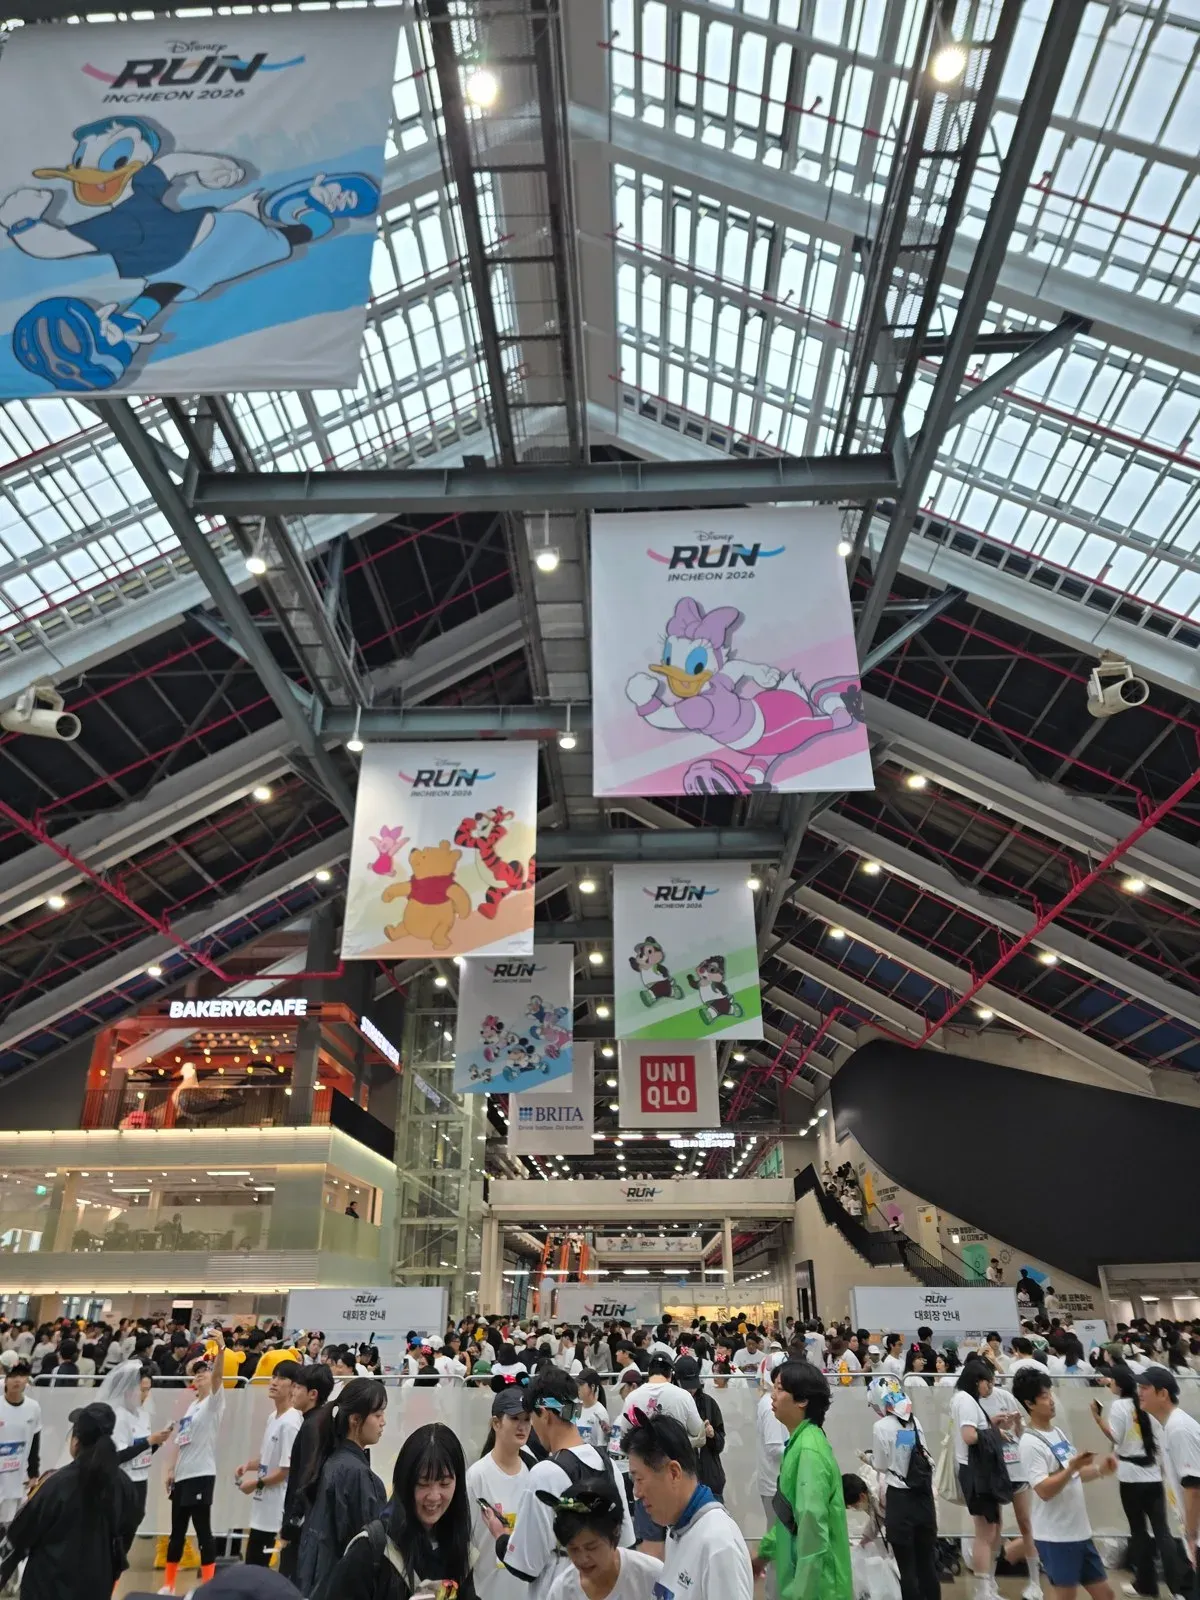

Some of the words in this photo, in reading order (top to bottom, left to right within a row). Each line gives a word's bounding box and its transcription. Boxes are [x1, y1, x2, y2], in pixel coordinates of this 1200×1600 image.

[165, 40, 228, 54] Disney
[109, 52, 268, 89] RUN
[102, 90, 195, 104] INCHEON
[197, 89, 246, 100] 2026
[693, 530, 735, 542] Disney
[668, 543, 762, 570] RUN
[667, 572, 723, 582] INCHEON
[725, 571, 756, 580] 2026
[412, 769, 479, 788] RUN
[451, 789, 472, 797] 2026
[654, 885, 706, 901] RUN
[493, 963, 536, 977] RUN
[169, 998, 308, 1018] BAKERY&CAFE
[646, 1062, 686, 1082] UNI
[647, 1085, 691, 1109] QLO
[535, 1106, 584, 1121] BRITA
[626, 1187, 656, 1198] RUN
[355, 1295, 378, 1304] RUN
[924, 1295, 948, 1304] RUN
[342, 1310, 368, 1321] 대회장
[369, 1310, 387, 1321] 안내
[591, 1304, 628, 1317] RUN
[914, 1309, 941, 1321] 대회장
[942, 1309, 961, 1321] 안내
